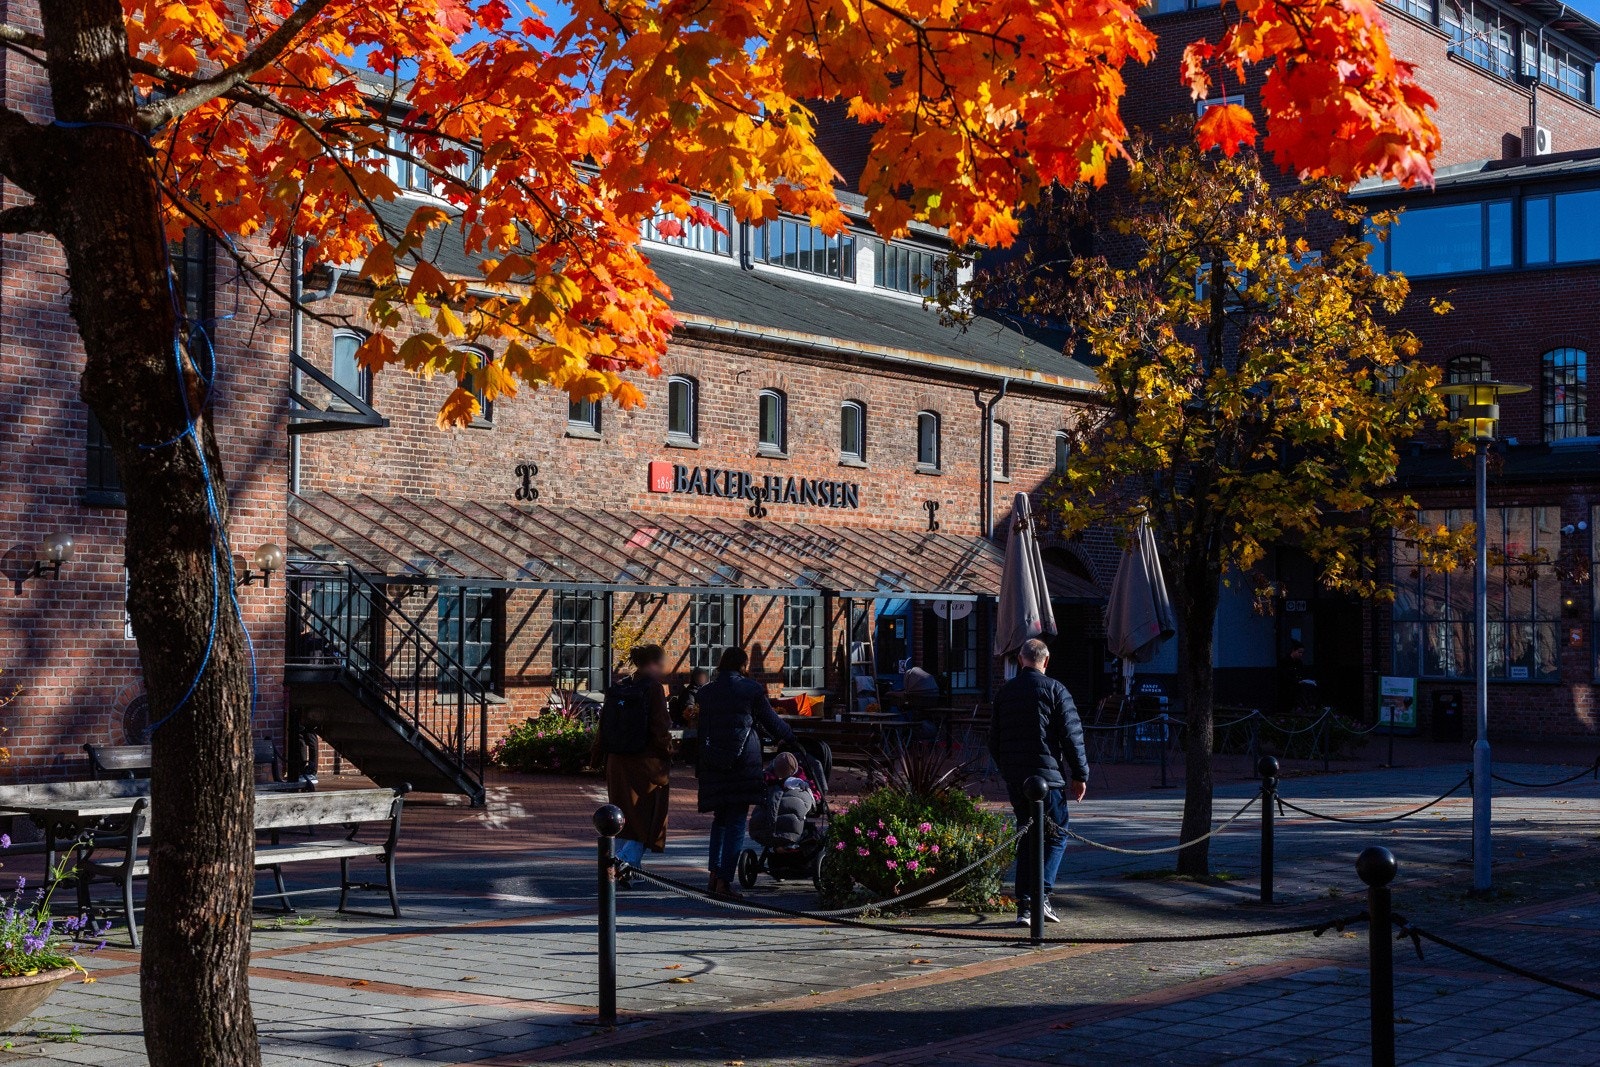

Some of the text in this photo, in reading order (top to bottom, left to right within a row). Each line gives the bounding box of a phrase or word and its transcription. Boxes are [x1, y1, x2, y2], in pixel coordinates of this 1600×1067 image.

[657, 464, 860, 509] 1861 BAKER HANSEN
